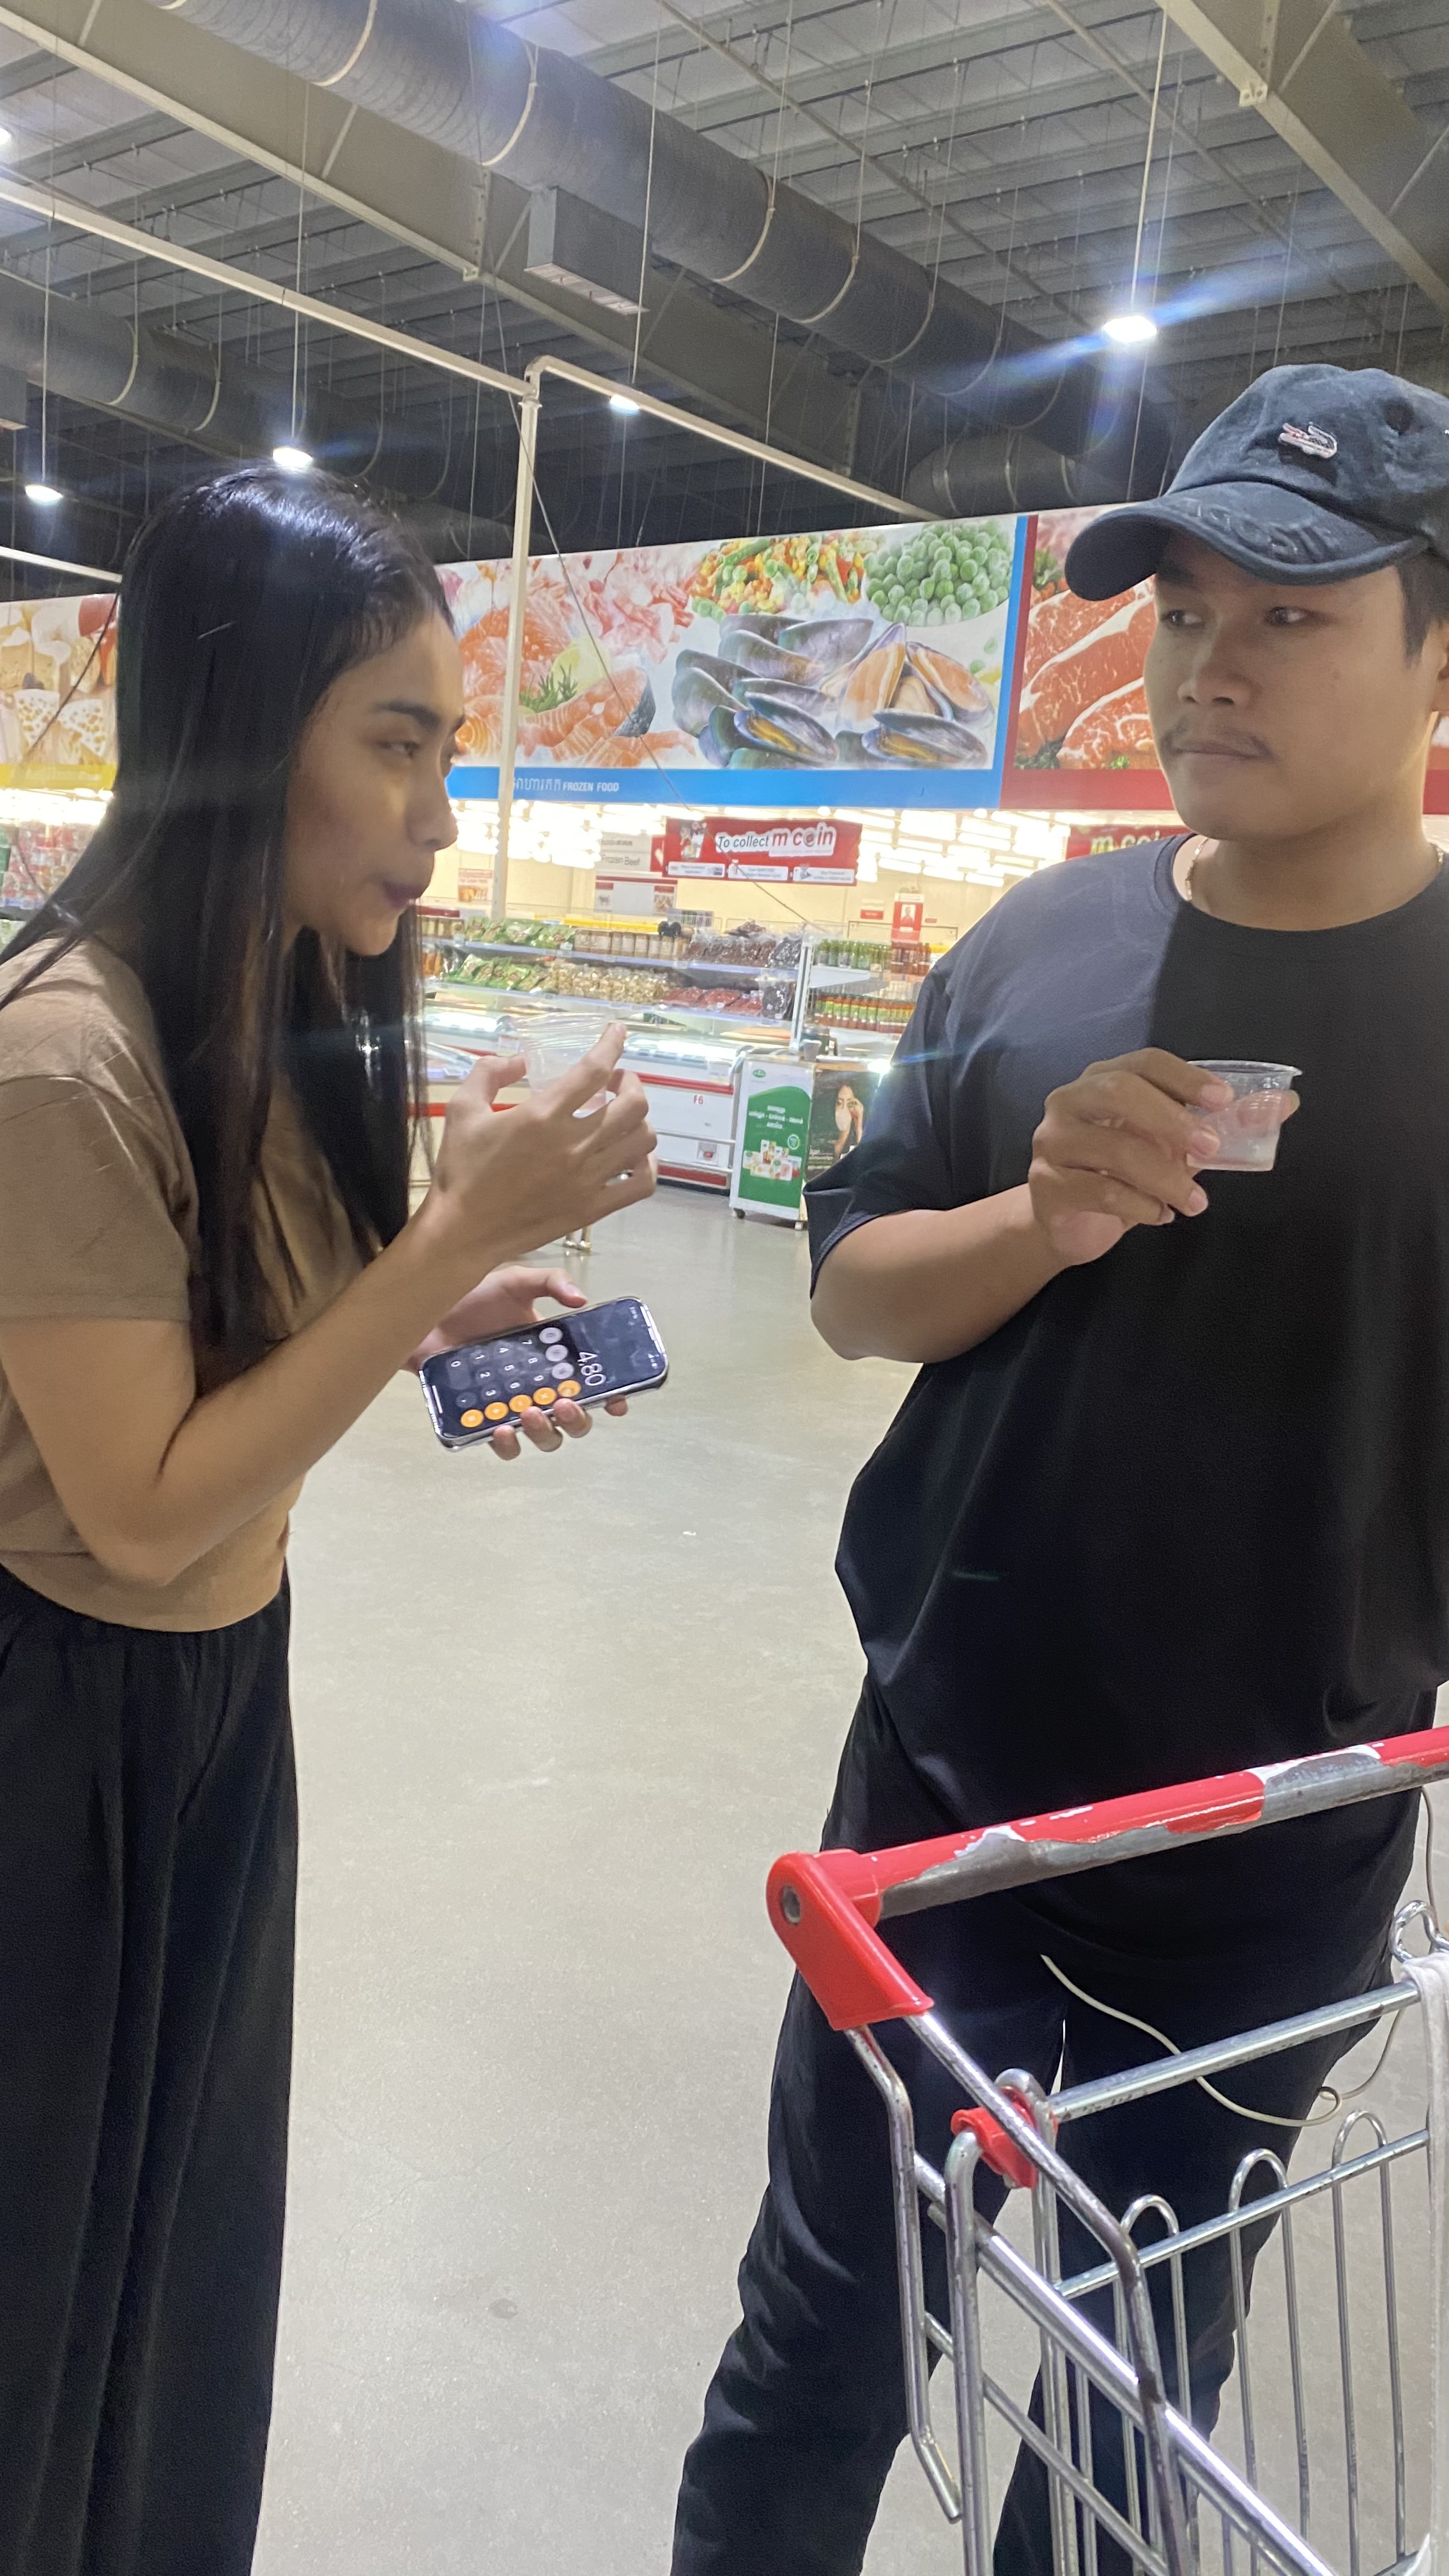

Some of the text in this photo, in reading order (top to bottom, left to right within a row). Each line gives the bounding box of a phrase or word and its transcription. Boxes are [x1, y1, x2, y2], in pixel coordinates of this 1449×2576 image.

[563, 781, 619, 792] FROZEN FOOD
[718, 836, 730, 848] To
[733, 835, 769, 848] collect
[693, 1094, 704, 1105] F6
